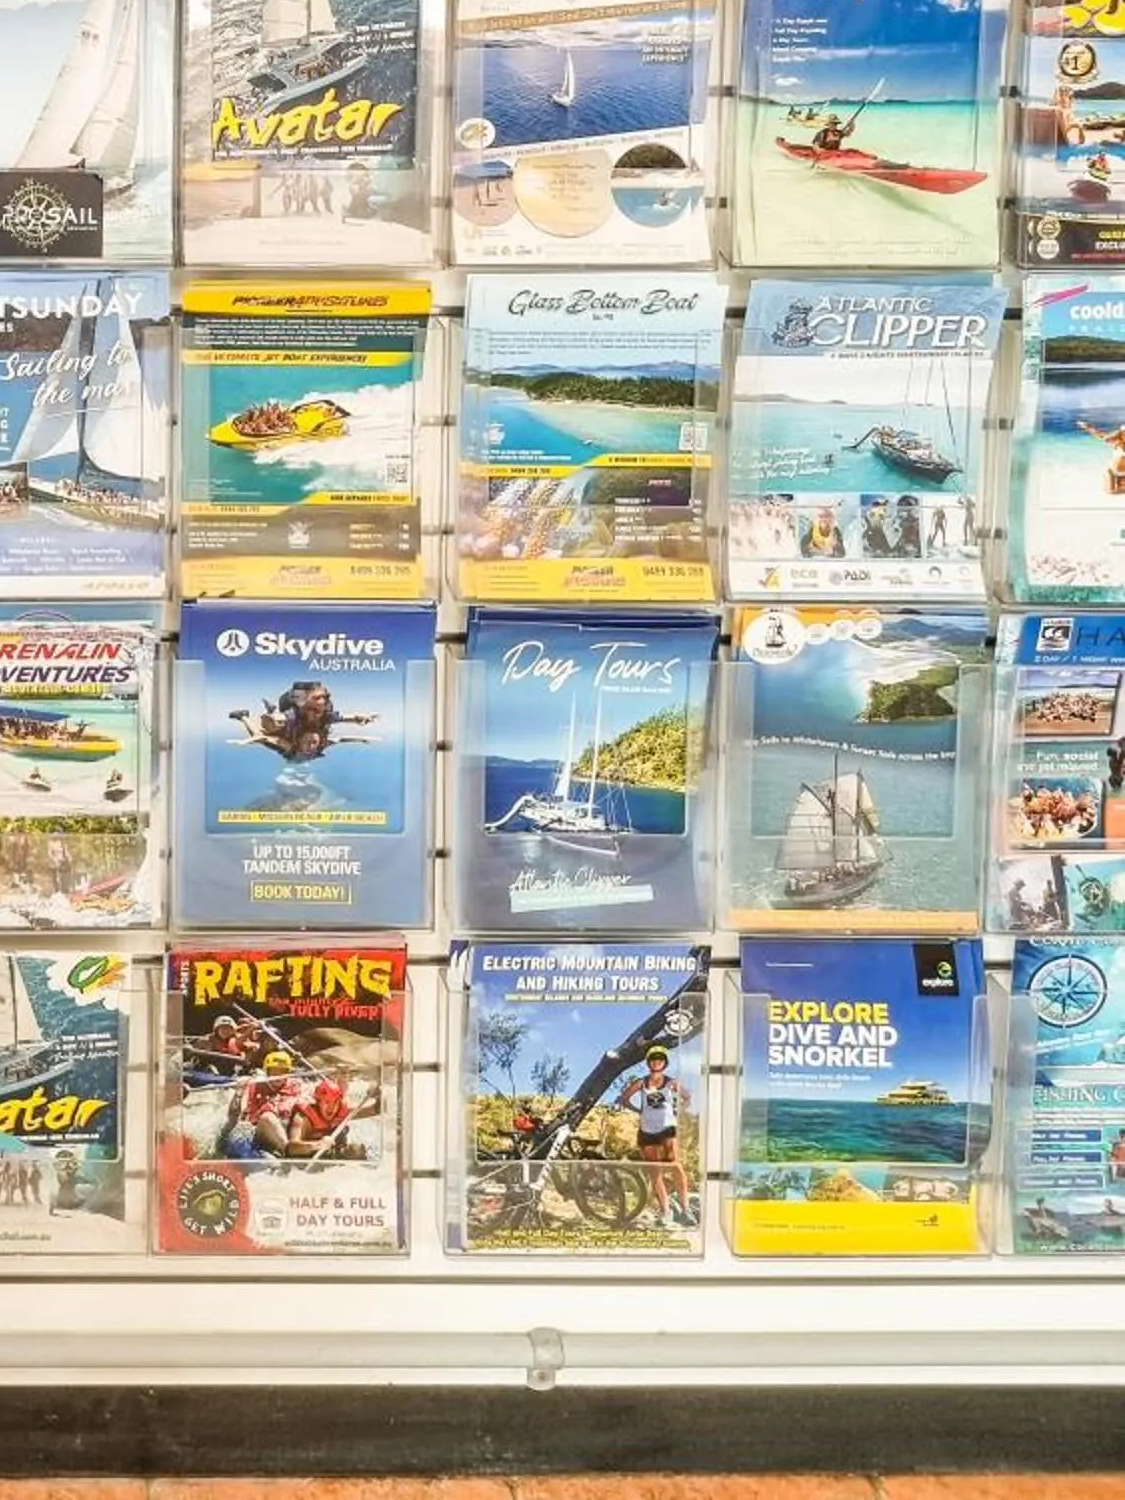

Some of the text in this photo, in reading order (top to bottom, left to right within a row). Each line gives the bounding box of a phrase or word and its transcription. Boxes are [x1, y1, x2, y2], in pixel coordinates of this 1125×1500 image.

[212, 87, 404, 150] Avatar
[2, 204, 99, 227] PROSAIL
[508, 288, 699, 317] Glass Bottom Boat
[814, 296, 934, 313] ATLANTIC
[809, 312, 988, 349] CLIPPER
[32, 378, 74, 408] the
[254, 632, 384, 664] Skydive
[309, 658, 396, 673] AUSTRALIA
[500, 639, 682, 693] Day Tours
[841, 741, 849, 752] &
[253, 844, 273, 860] UP
[275, 844, 293, 860] TO
[242, 860, 363, 875] TANDEM SKYDIVE
[253, 884, 345, 901] BOOK TODAY!
[483, 954, 697, 972] ELECTRIC MOUNTAIN BIKING
[194, 954, 392, 1006] RAFTING
[516, 975, 661, 991] AND HIKING TOURS
[922, 977, 955, 989] explore
[768, 1000, 890, 1025] EXPLORE
[768, 1023, 899, 1047] DIVE AND
[768, 1045, 894, 1068] SNORKEL
[289, 1196, 387, 1210] HALF & FULL
[183, 1217, 208, 1236] GET
[295, 1213, 385, 1228] DAY TOURS
